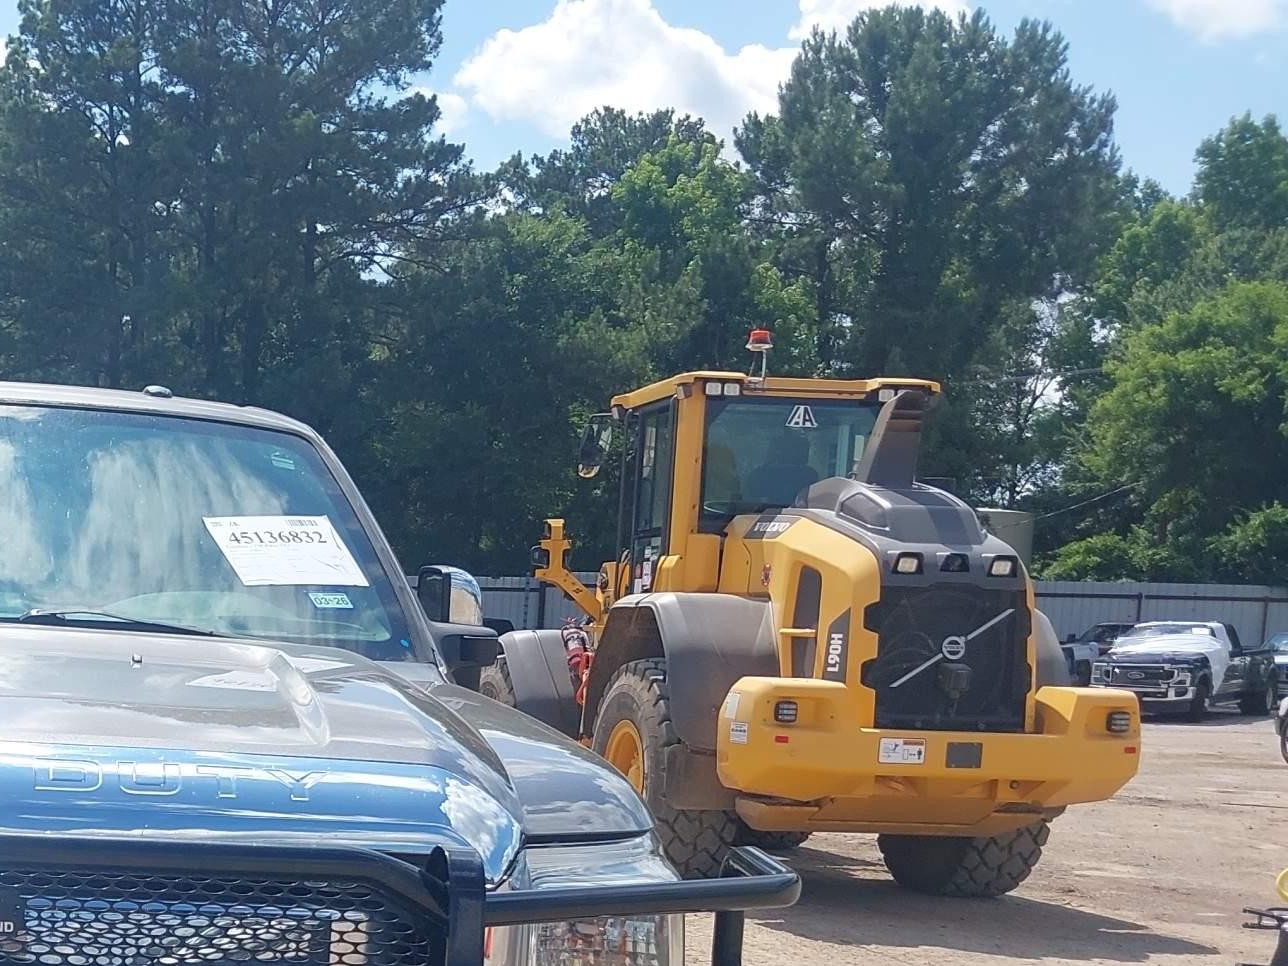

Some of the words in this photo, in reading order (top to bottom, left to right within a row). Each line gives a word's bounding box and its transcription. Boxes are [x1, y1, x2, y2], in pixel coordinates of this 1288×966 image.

[228, 530, 327, 544] 45136832
[753, 522, 791, 532] VOLVO
[826, 633, 844, 672] L90H
[33, 756, 330, 801] DUTY
